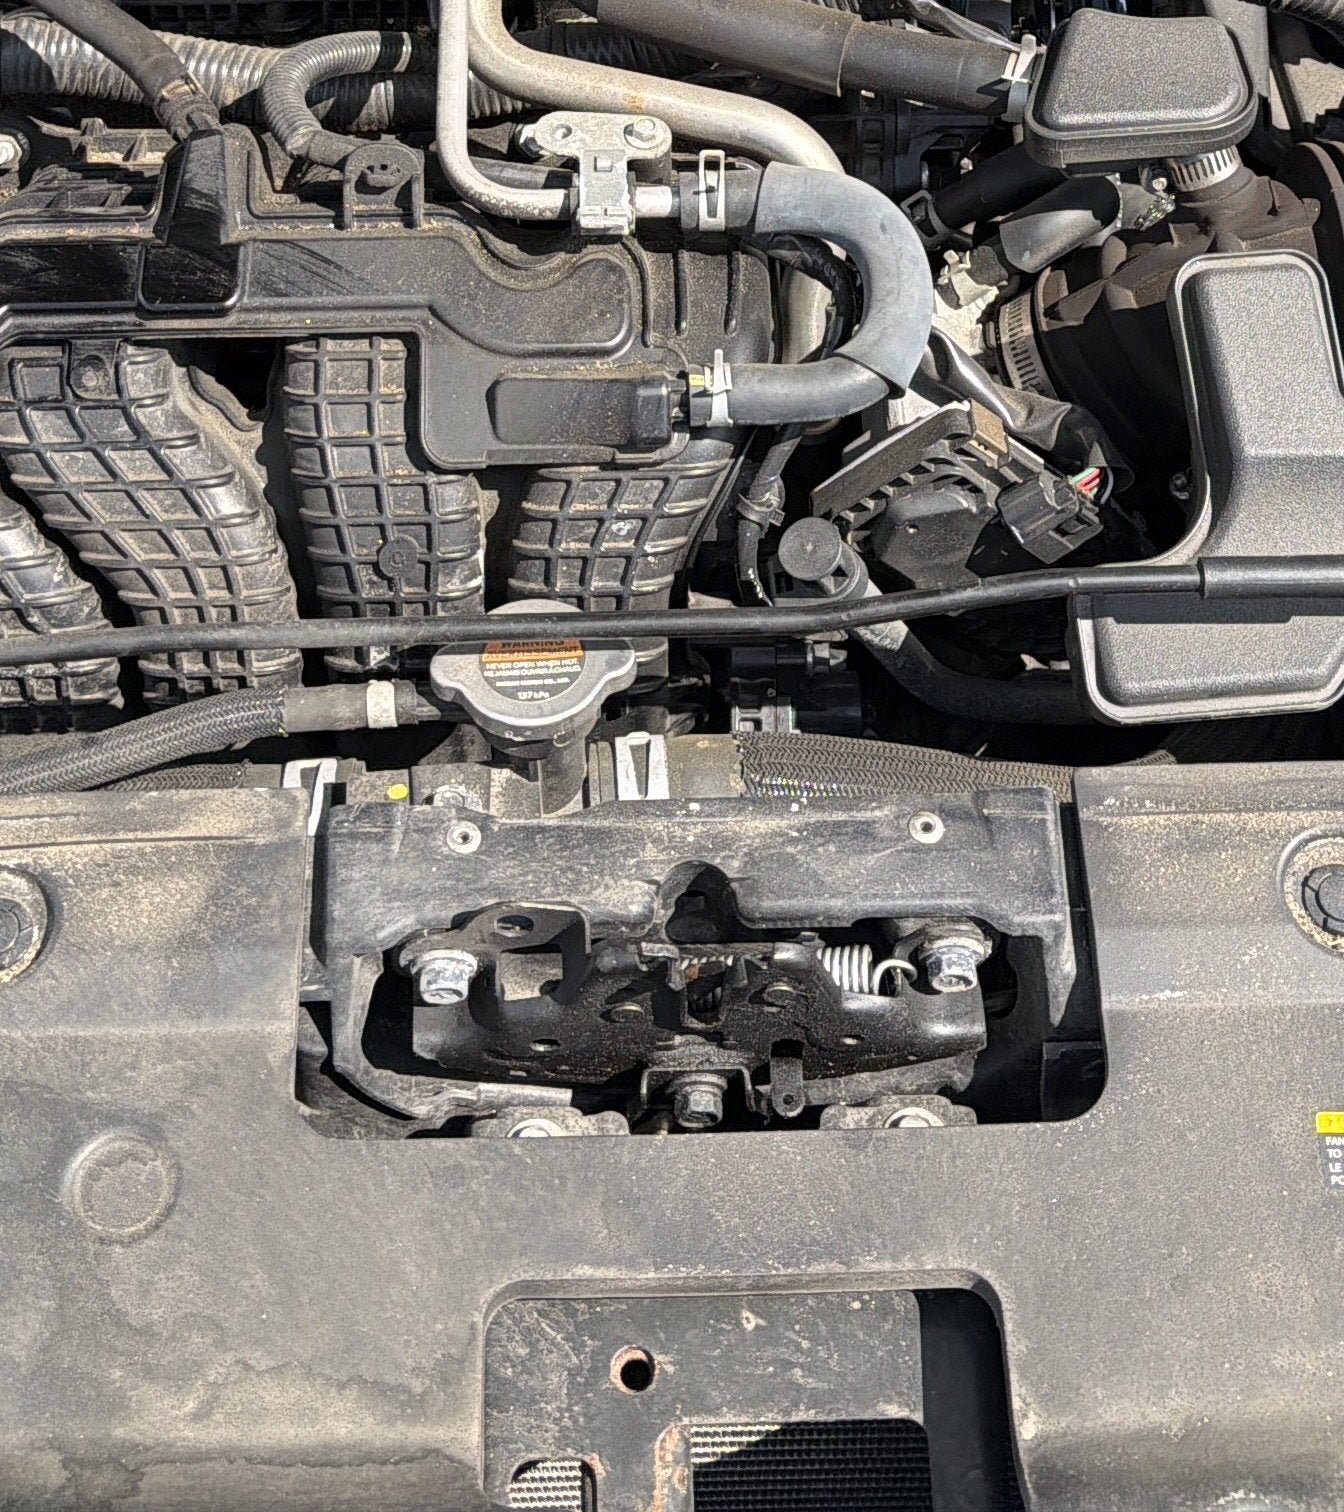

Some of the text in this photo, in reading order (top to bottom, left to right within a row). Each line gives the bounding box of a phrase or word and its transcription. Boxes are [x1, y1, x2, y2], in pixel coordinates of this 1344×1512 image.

[486, 662, 512, 670] NEVER
[513, 661, 535, 669] OPEN
[517, 691, 533, 700] 137
[1326, 1148, 1342, 1159] TO
[1328, 1162, 1342, 1173] LE
